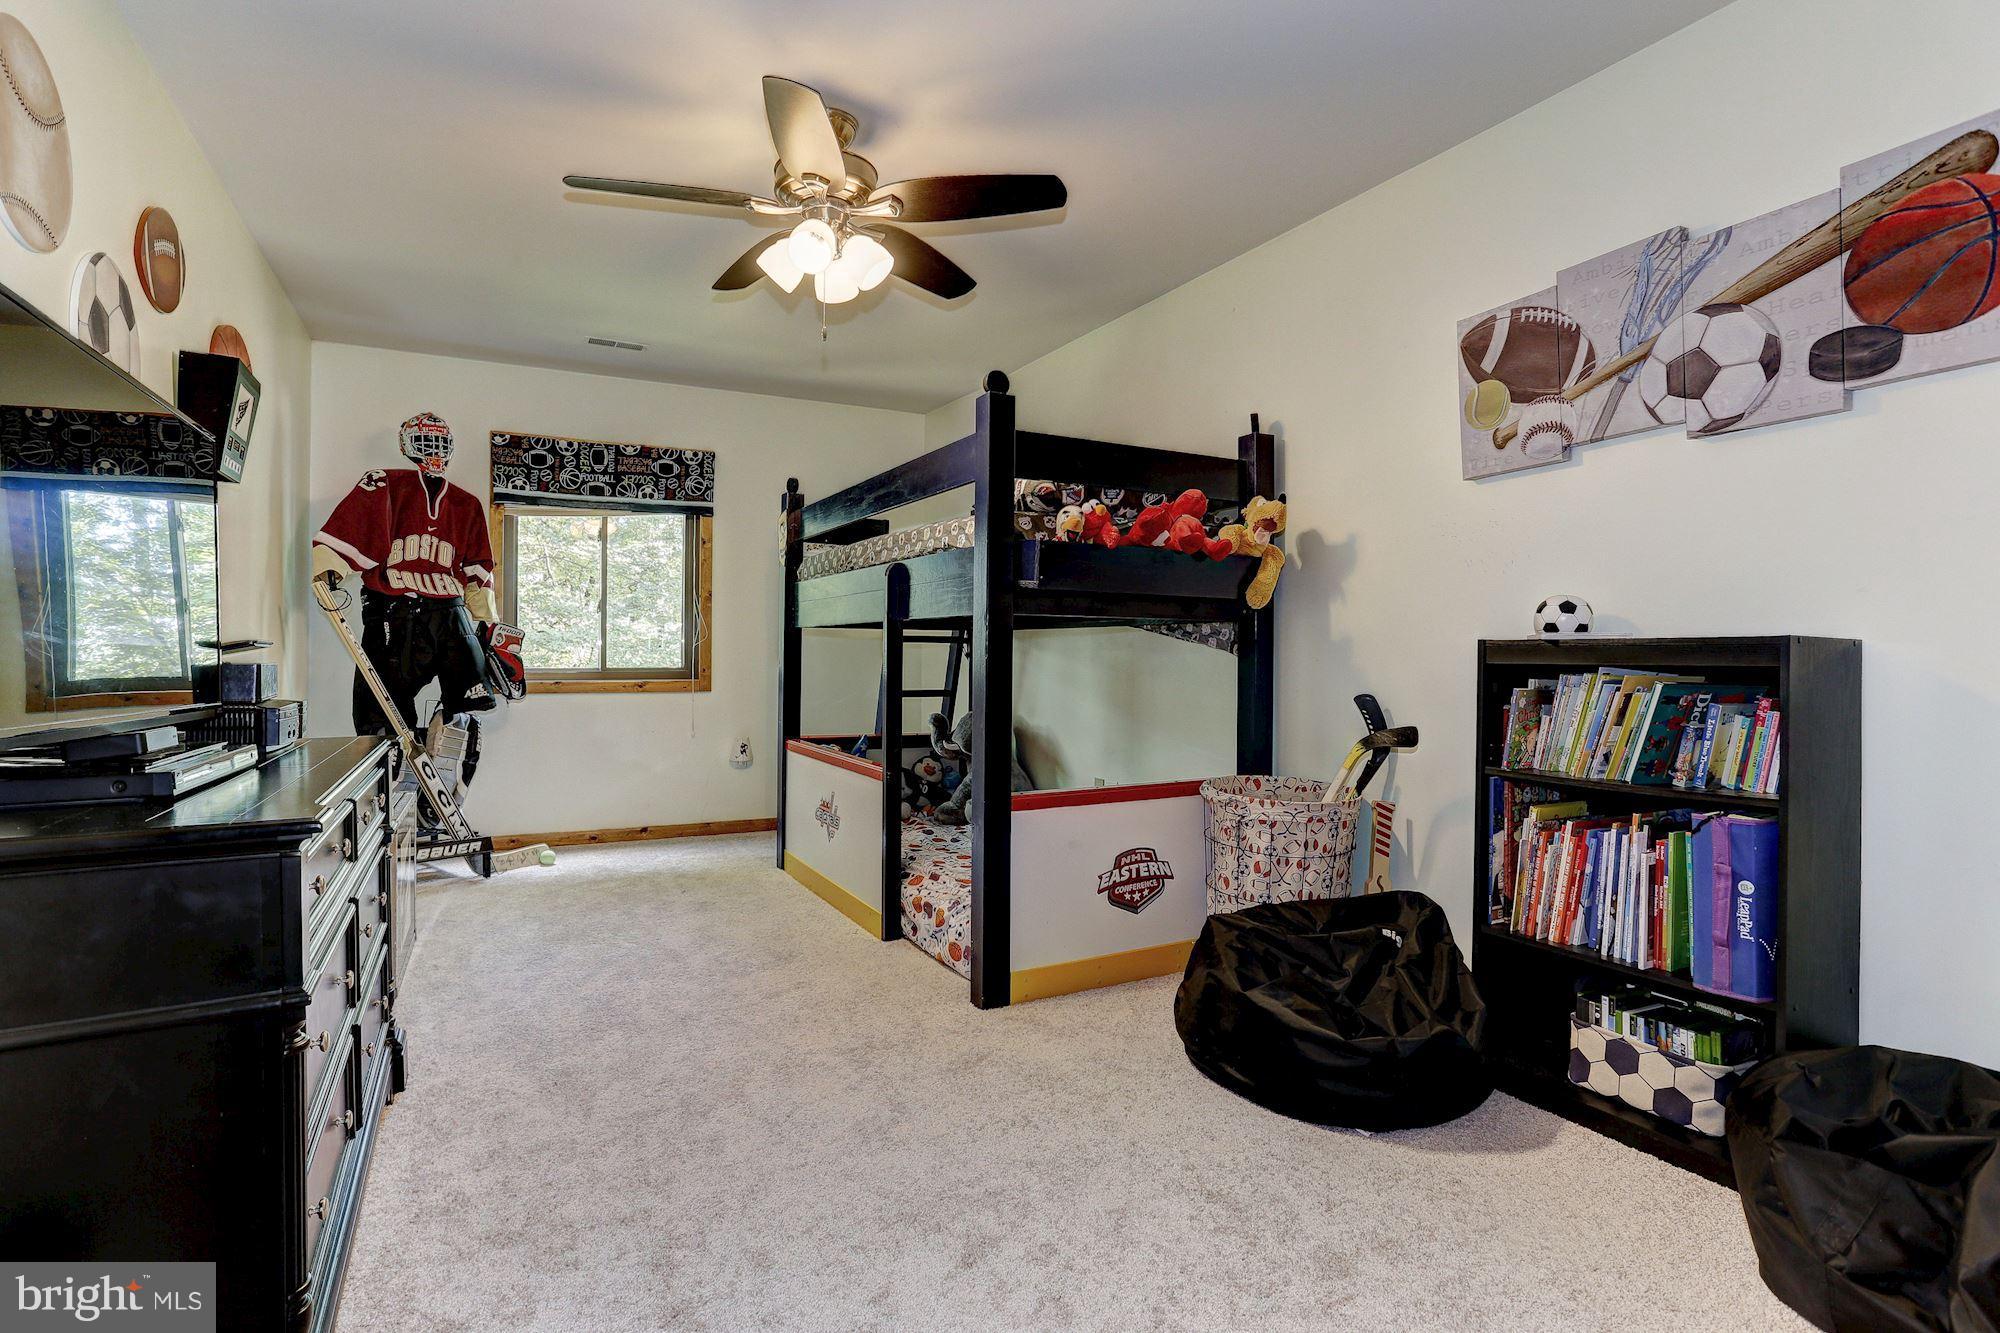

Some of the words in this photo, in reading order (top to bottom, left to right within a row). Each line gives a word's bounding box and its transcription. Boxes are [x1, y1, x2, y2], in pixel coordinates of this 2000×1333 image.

[387, 533, 456, 569] BOSTO
[1705, 718, 1716, 739] Little
[1702, 740, 1712, 757] Blue
[416, 840, 482, 861] BAUER
[1121, 852, 1151, 866] NHL
[1099, 861, 1173, 890] EASTERN
[1115, 879, 1159, 895] CONFERENCE
[1740, 895, 1755, 943] LeapPad
